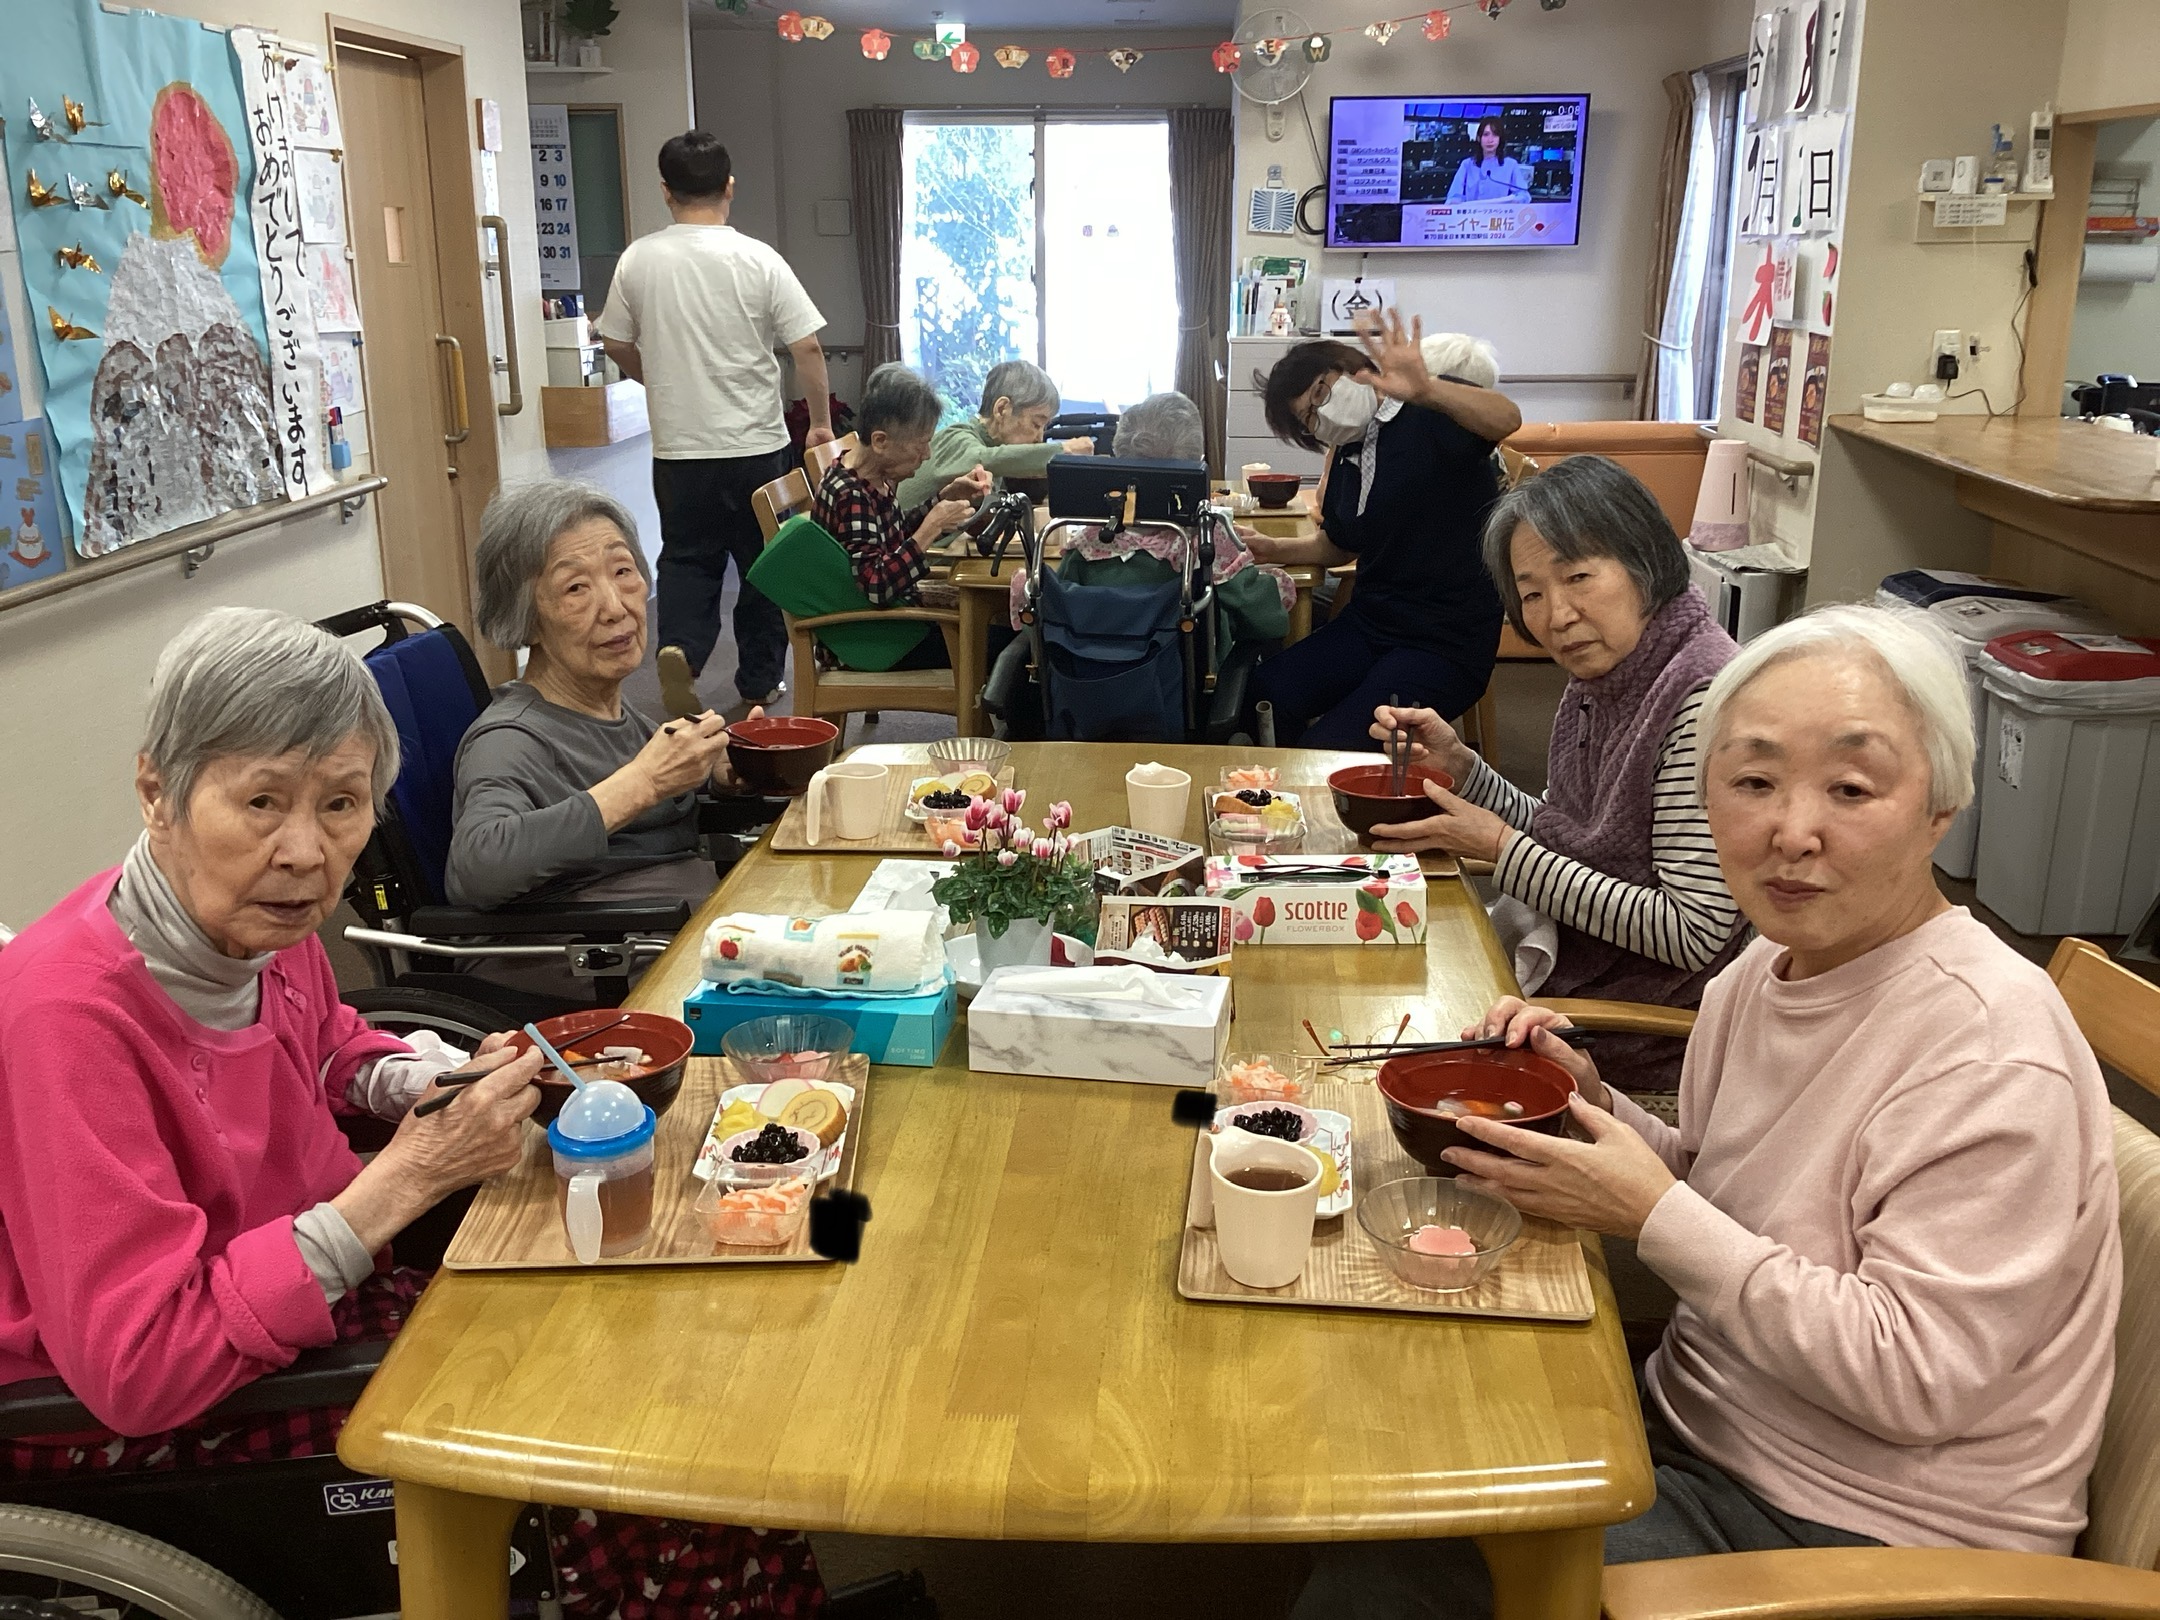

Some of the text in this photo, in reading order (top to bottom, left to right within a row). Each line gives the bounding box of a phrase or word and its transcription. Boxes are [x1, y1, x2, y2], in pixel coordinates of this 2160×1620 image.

[257, 40, 305, 277] あけまして
[538, 150, 563, 162] 2 3
[540, 174, 566, 187] 9 10
[540, 198, 568, 211] 16 17
[541, 222, 570, 235] 23 24
[1424, 217, 1515, 232] ニューイヤー駅伝
[543, 246, 571, 259] 30 31
[253, 104, 309, 497] おめでとうございます
[1286, 925, 1345, 933] FLOWERBOX
